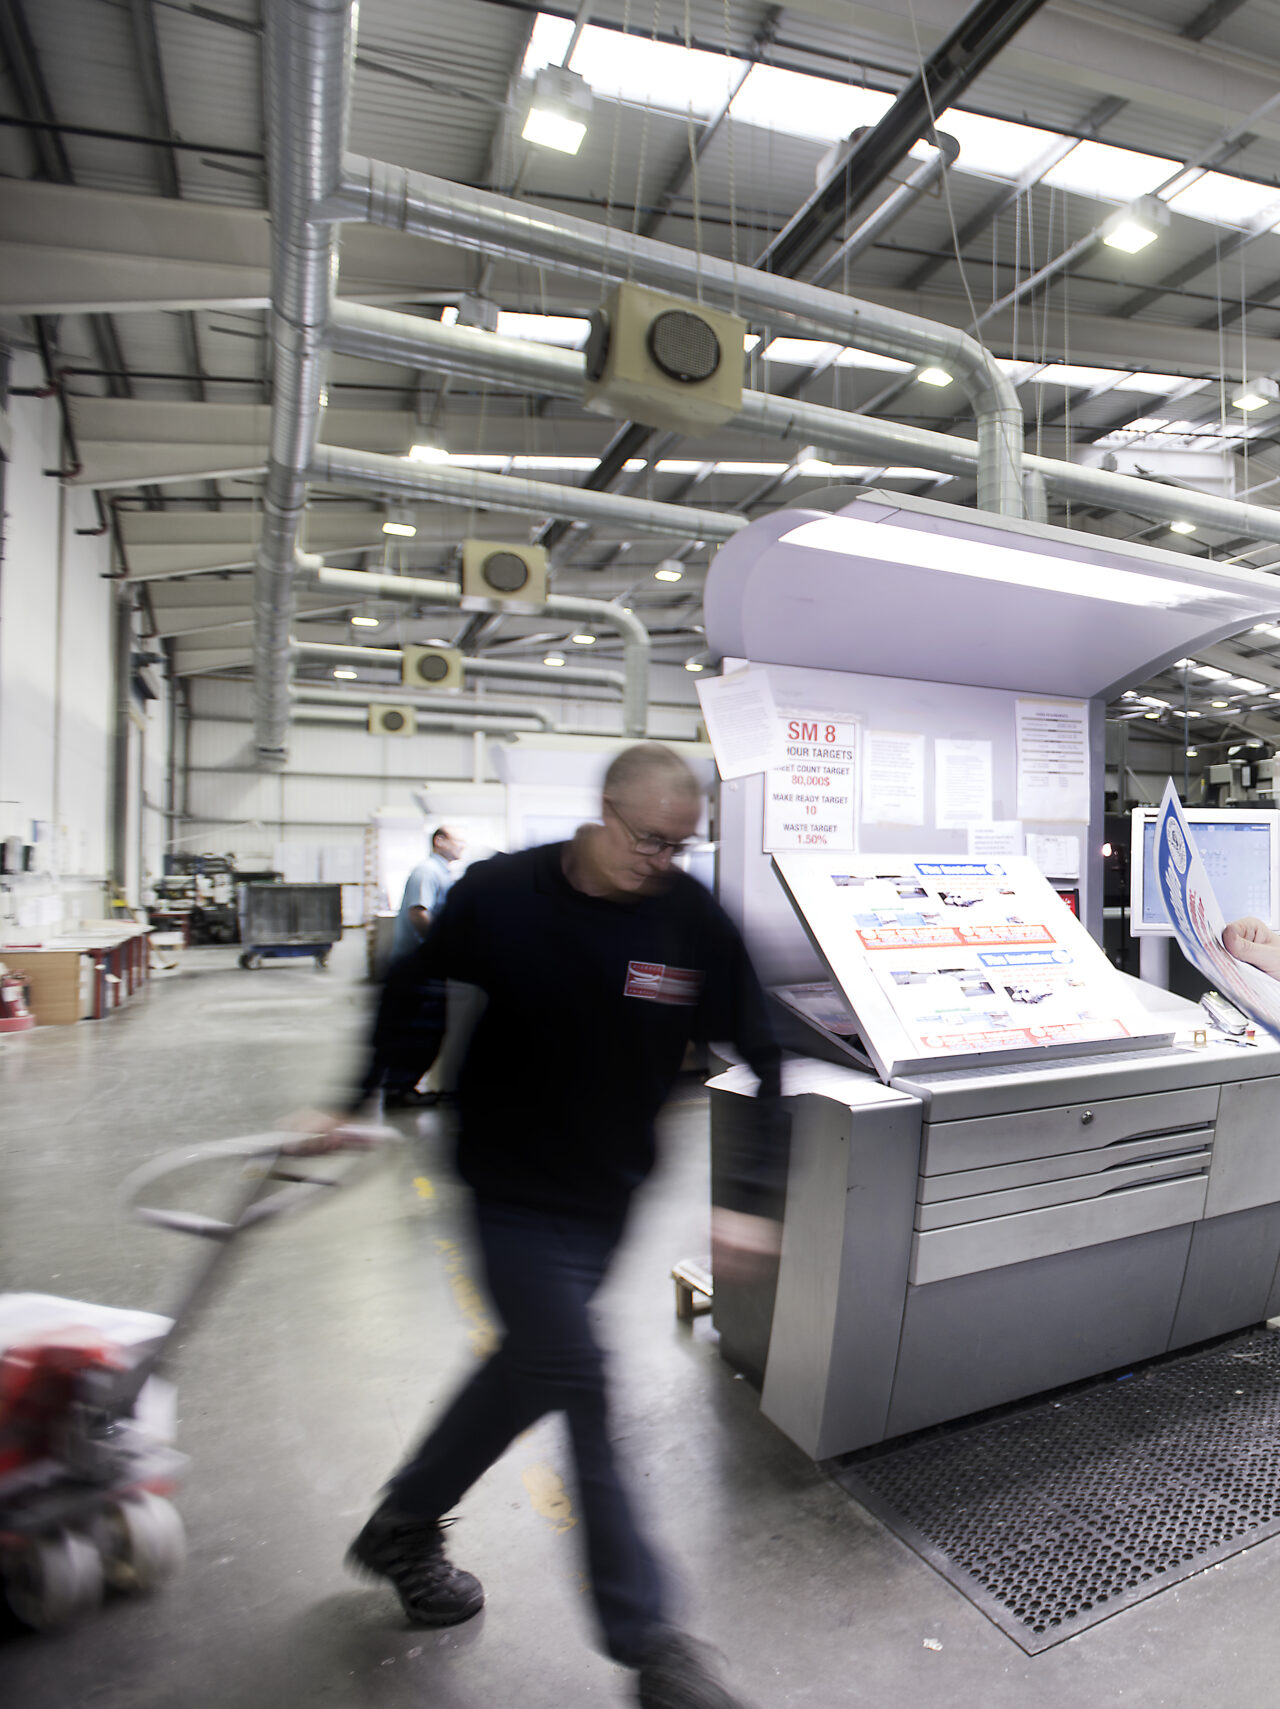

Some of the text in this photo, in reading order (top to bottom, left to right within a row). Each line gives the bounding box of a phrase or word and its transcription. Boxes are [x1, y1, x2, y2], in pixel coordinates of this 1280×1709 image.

[788, 721, 836, 743] SM 8
[812, 748, 852, 760] TARGETS
[797, 765, 820, 774] COUNT
[823, 766, 850, 775] TARGET
[773, 793, 848, 804] MAKE READY TARGET
[806, 805, 817, 815] 10
[783, 823, 838, 832] WASTE TARGET
[798, 834, 827, 844] 1.50%
